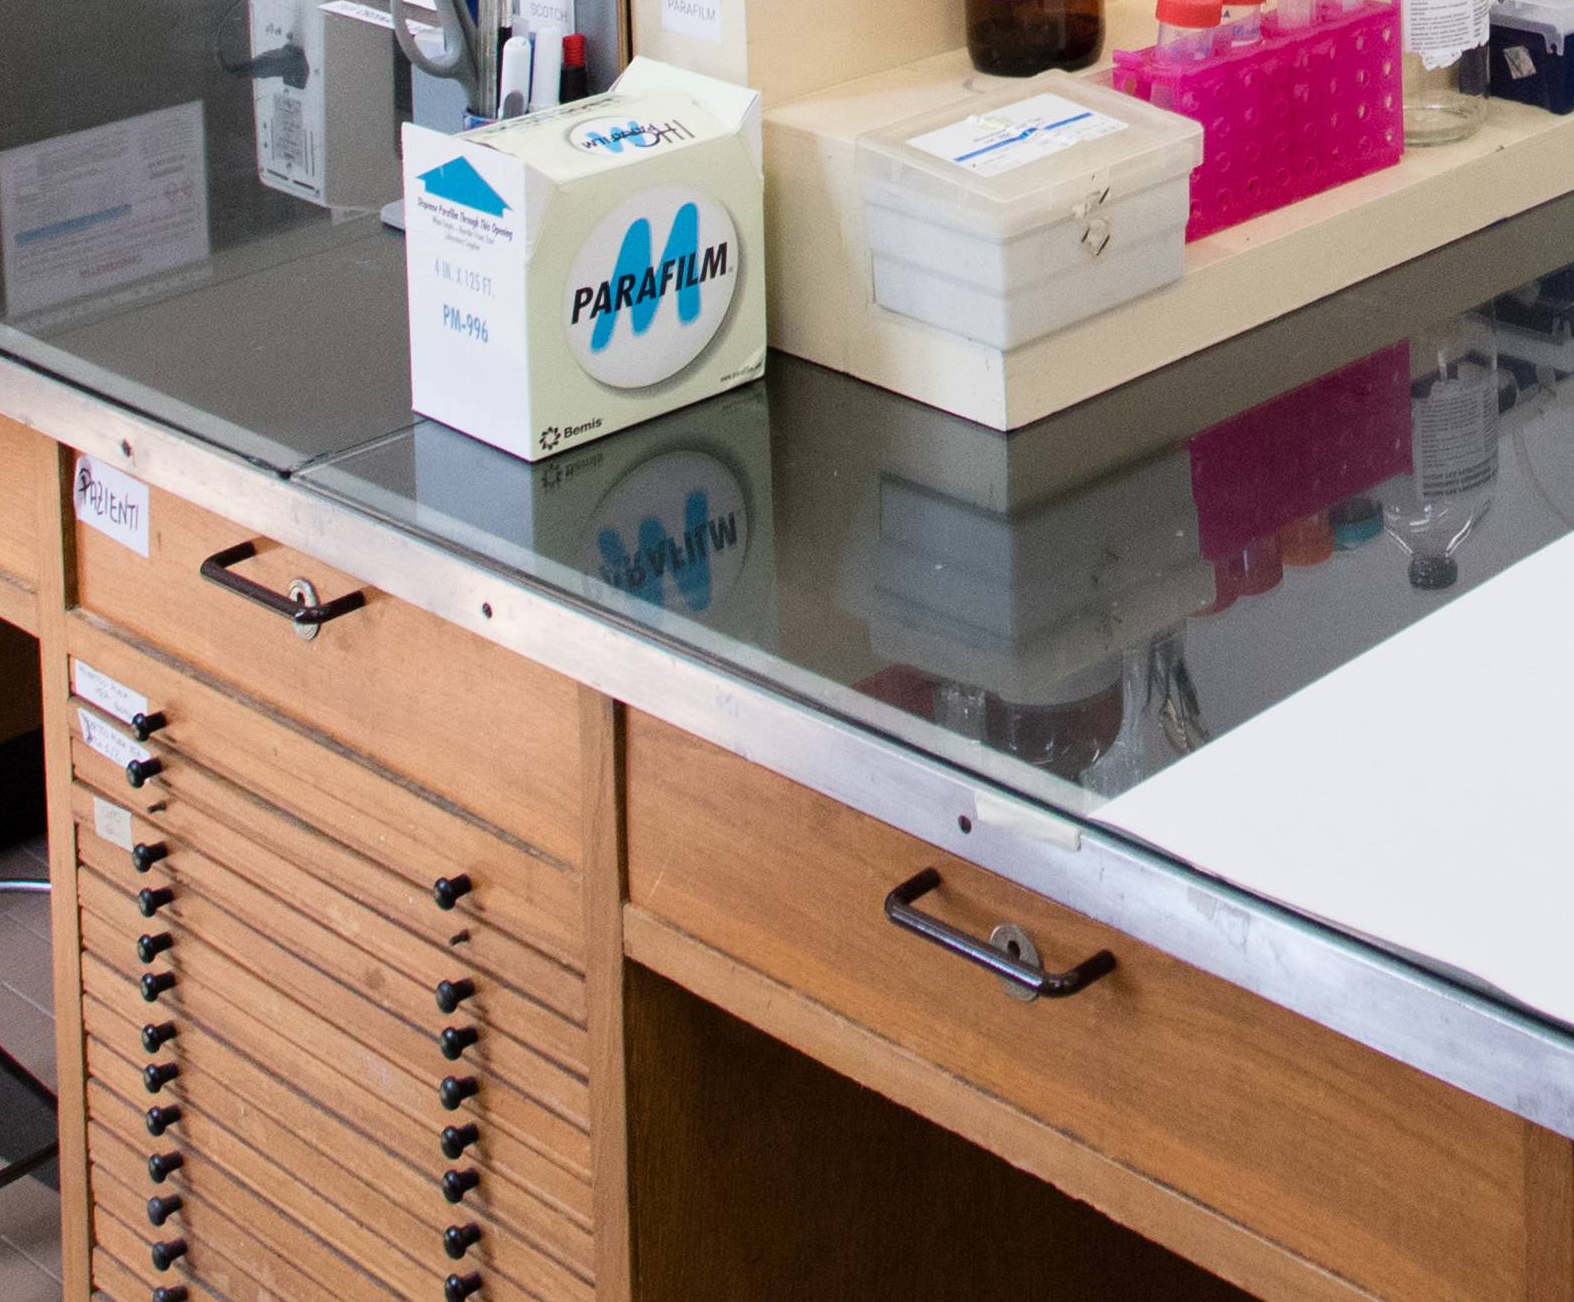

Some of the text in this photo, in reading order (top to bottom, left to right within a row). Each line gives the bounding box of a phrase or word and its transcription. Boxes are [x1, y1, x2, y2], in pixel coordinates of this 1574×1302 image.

[529, 2, 569, 24] SCOTCH
[438, 204, 459, 221] Parafilm
[459, 211, 479, 230] Through
[480, 218, 492, 232] This
[491, 223, 514, 242] Opening
[442, 259, 454, 282] IN.
[463, 269, 481, 292] 125
[482, 277, 496, 298] FT.
[571, 241, 729, 326] PARAFILM
[442, 303, 490, 344] PM-996
[563, 417, 603, 439] Bemis
[78, 466, 139, 533] PAZIENTI
